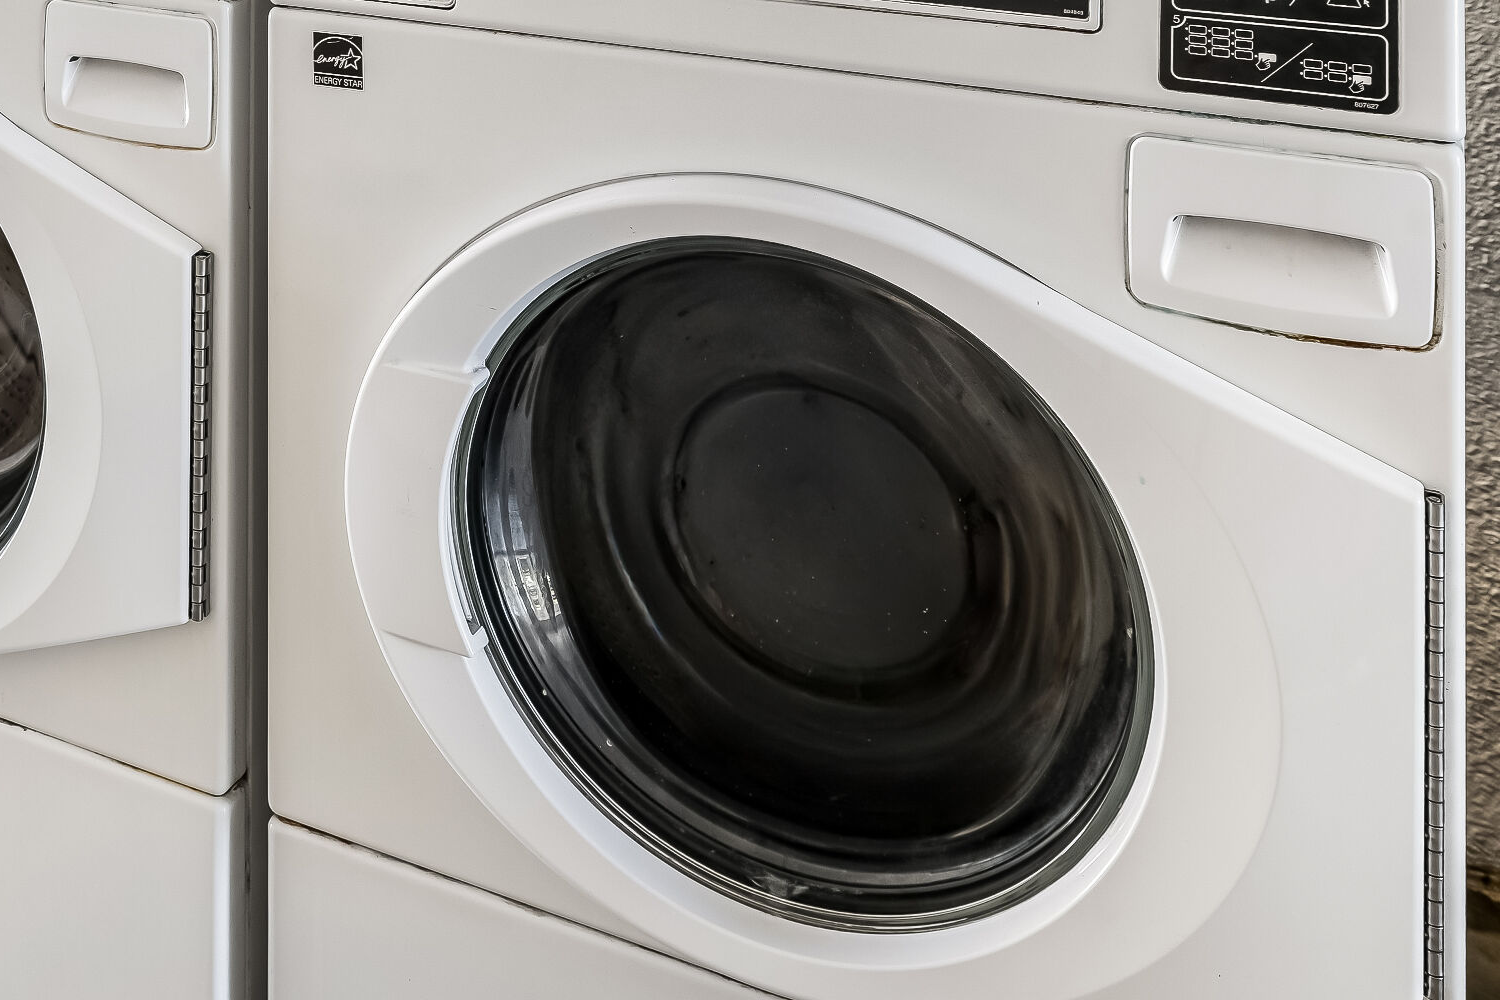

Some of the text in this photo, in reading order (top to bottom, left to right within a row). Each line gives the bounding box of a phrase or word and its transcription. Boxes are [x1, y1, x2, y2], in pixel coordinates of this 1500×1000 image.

[1172, 15, 1180, 23] 5
[314, 54, 350, 69] energy
[314, 76, 362, 89] ENERGY STAR
